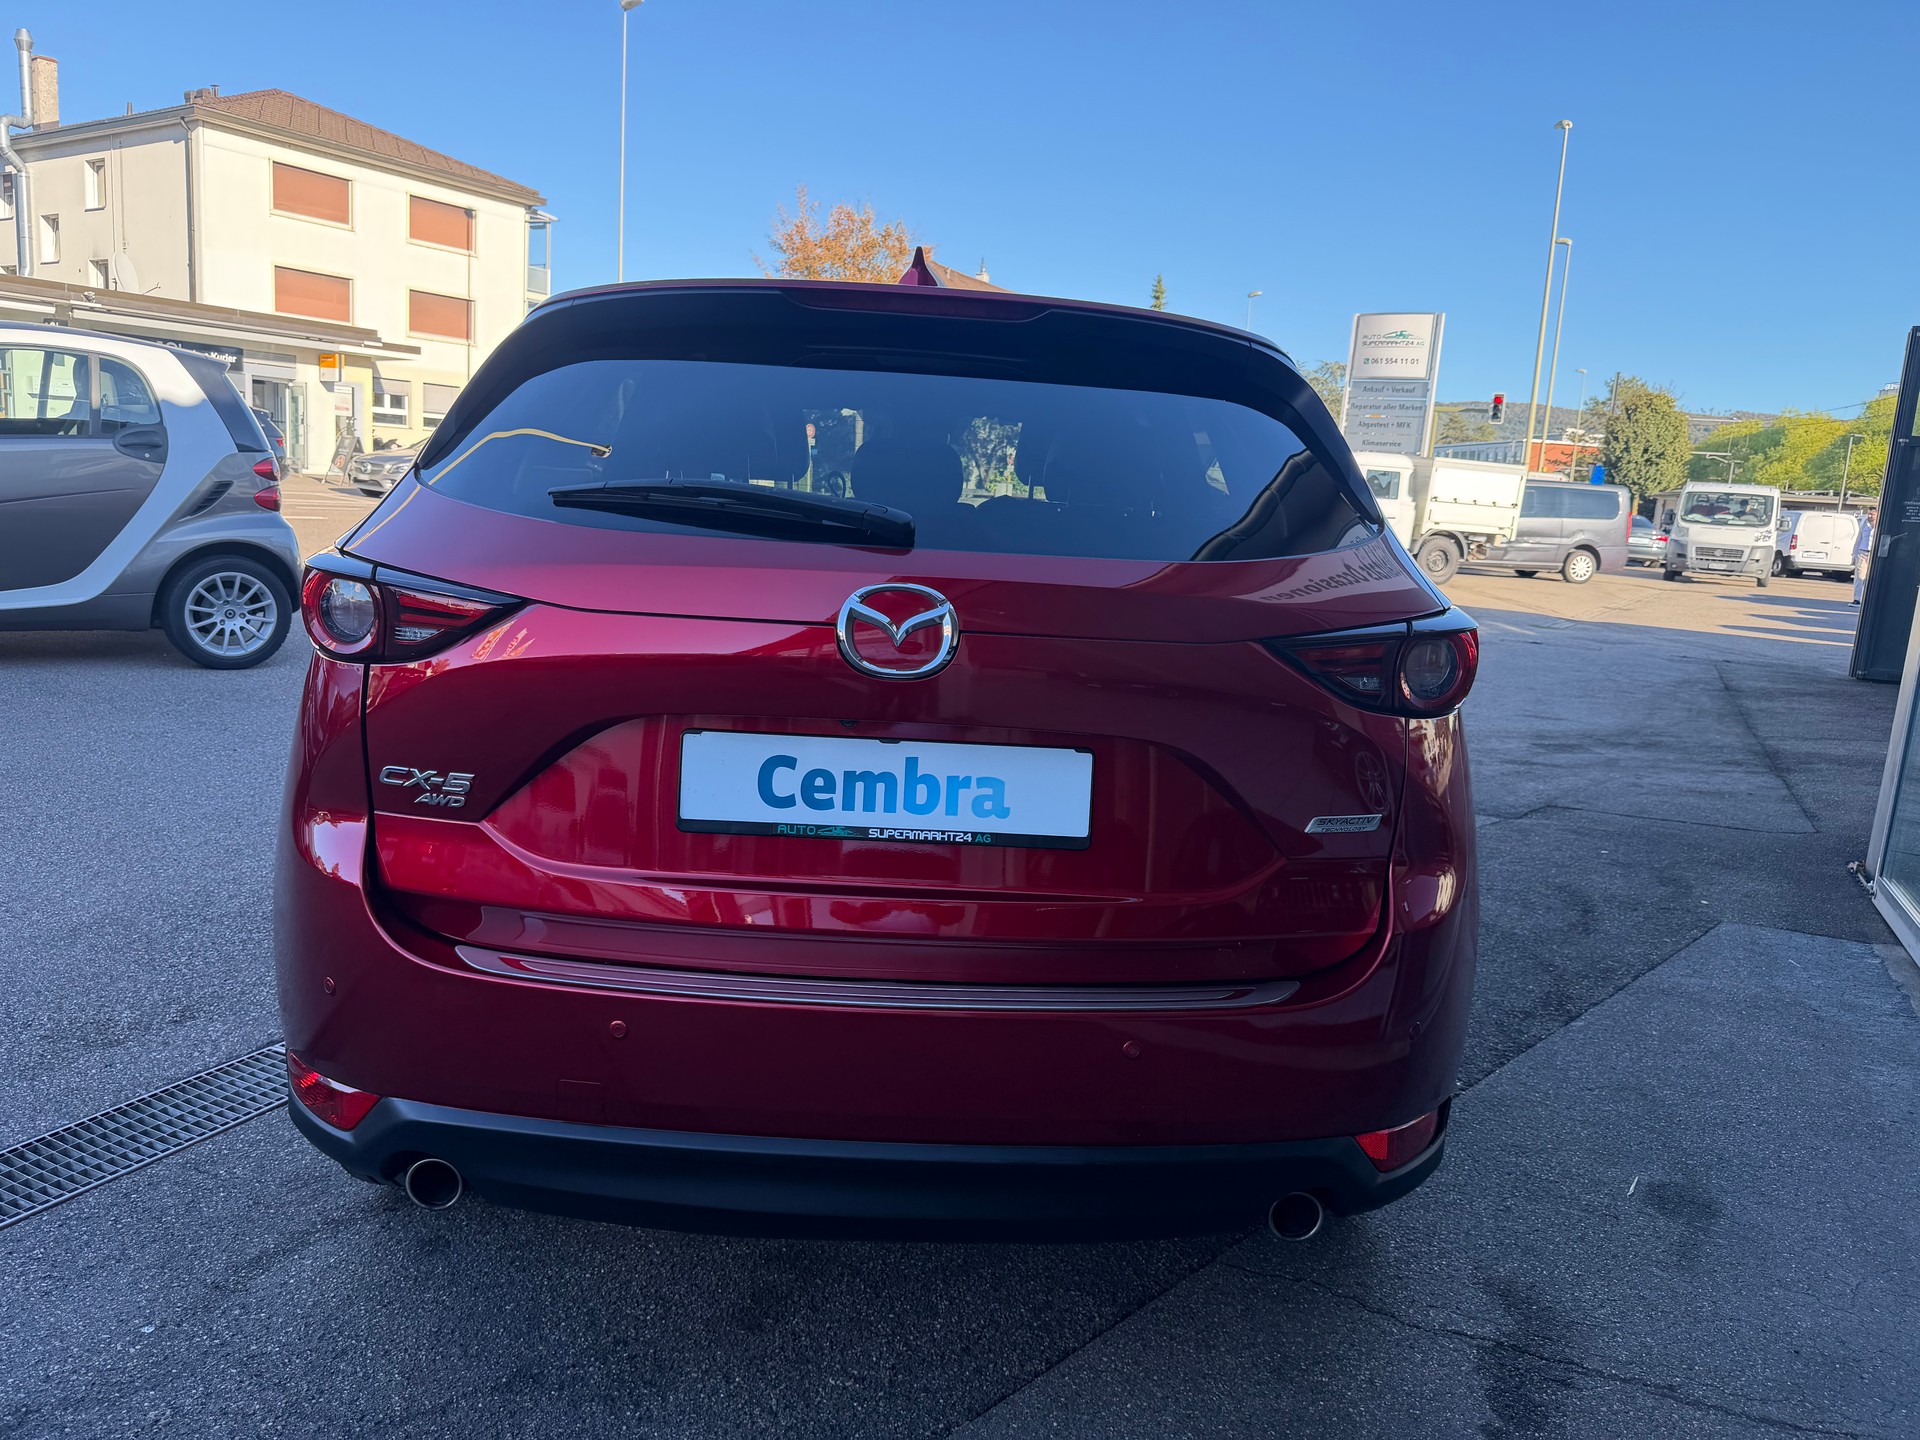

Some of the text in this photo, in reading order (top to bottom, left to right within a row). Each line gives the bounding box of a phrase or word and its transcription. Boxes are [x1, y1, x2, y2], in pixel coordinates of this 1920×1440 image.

[210, 351, 237, 363] Kurier
[1362, 385, 1385, 393] Ankauf
[1350, 403, 1382, 411] Reparatur
[1398, 403, 1423, 411] Marken
[1358, 420, 1389, 429] Abgastest
[1396, 421, 1411, 429] MFK
[1361, 439, 1402, 447] Klimaservice
[380, 765, 475, 795] CX-5
[757, 754, 1011, 819] Cembra
[414, 793, 466, 807] AWD
[1317, 816, 1376, 826] SKYACTIV
[777, 824, 816, 835] AUTO
[974, 833, 992, 843] AG
